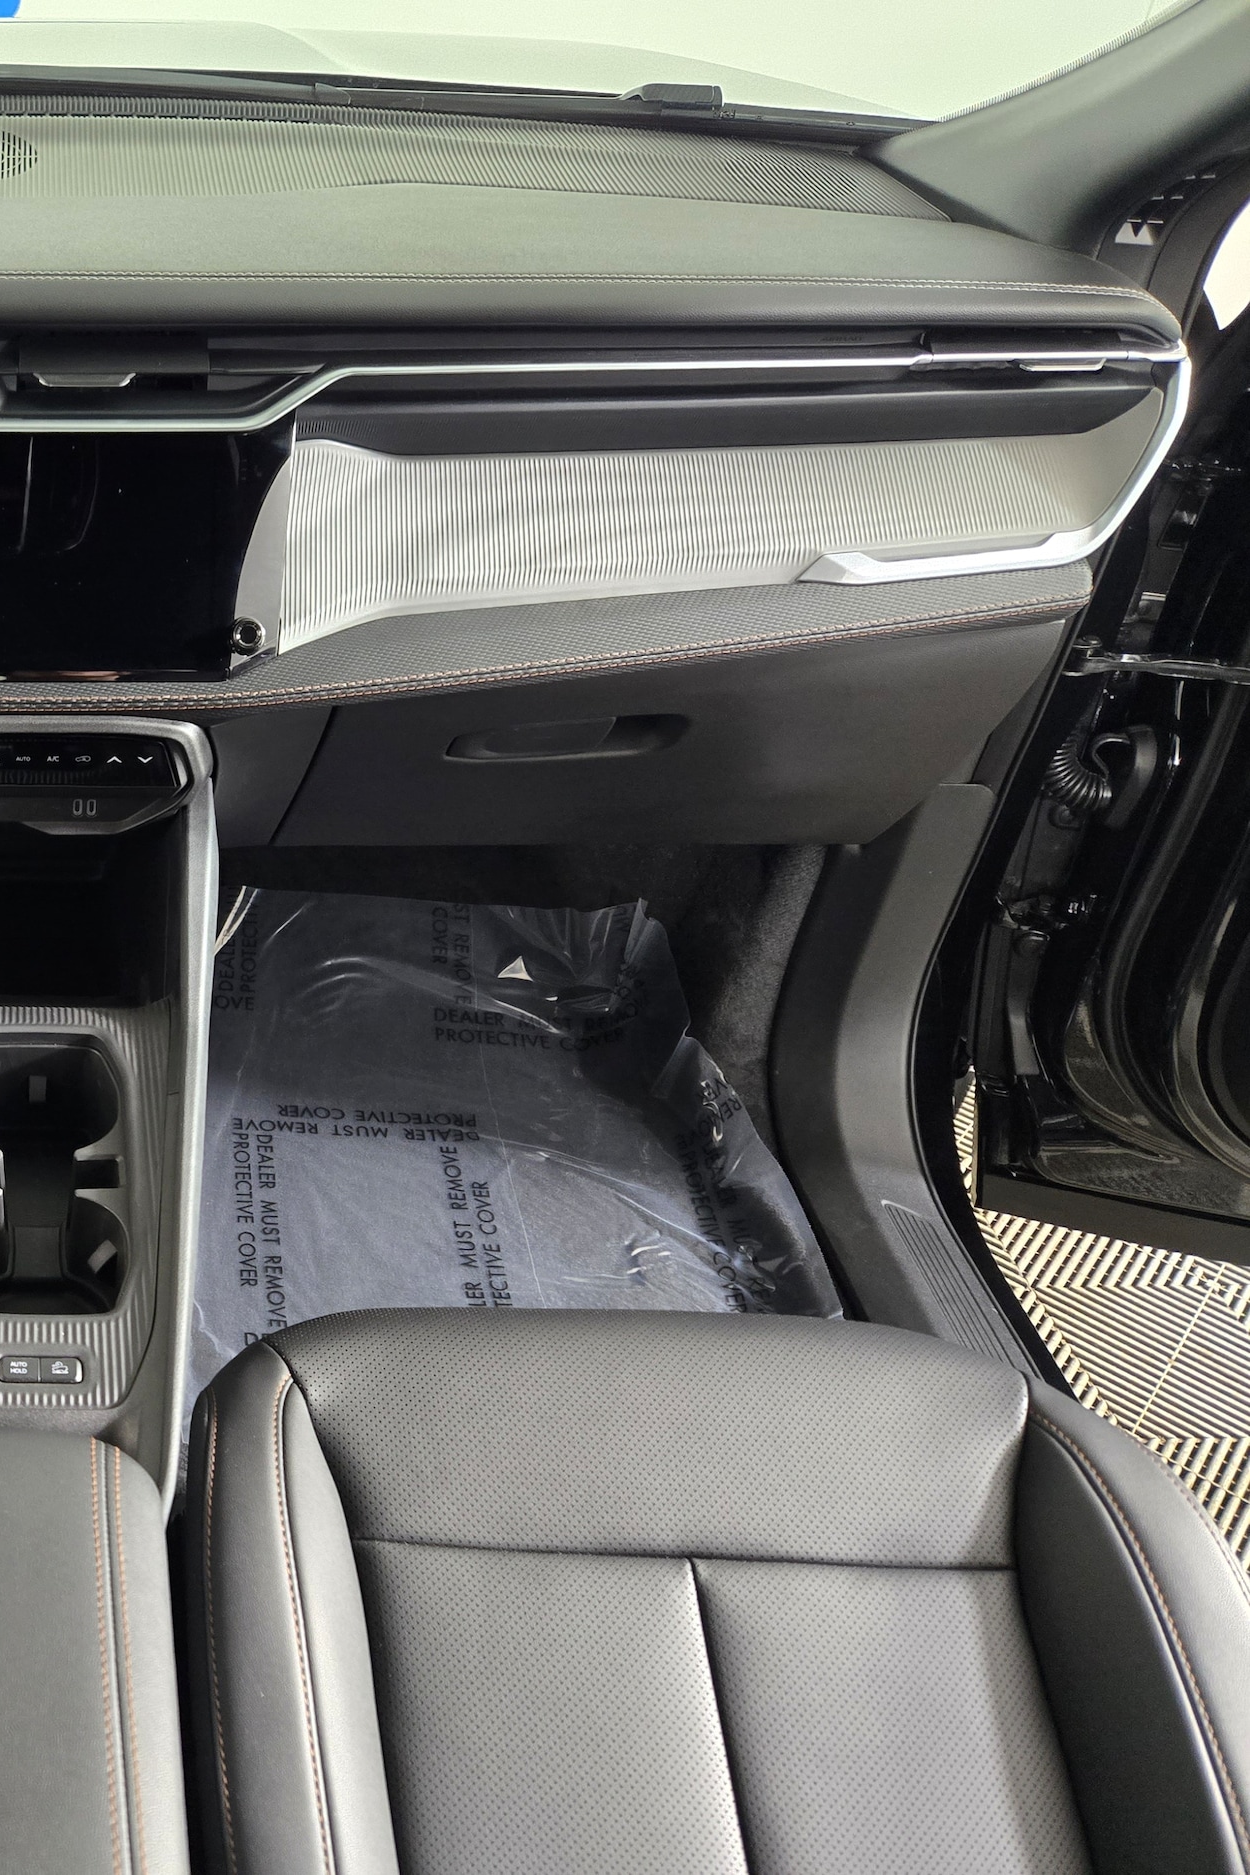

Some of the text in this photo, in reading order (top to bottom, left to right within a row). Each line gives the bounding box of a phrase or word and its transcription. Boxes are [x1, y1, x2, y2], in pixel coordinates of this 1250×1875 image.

[434, 1006, 504, 1027] DEALER
[434, 1026, 551, 1051] PROTECTIVE
[233, 1117, 480, 1142] DEALER MUST REMOVE
[278, 1104, 477, 1128] PROTECTIVE COVER
[233, 1132, 258, 1287] PROTECTIVE COVER
[257, 1134, 287, 1328] DEALER MUST REMOVE
[440, 1146, 487, 1306] LER MUST REMOVE
[471, 1181, 513, 1307] TECTIVE COVER
[713, 1250, 748, 1313] COVER
